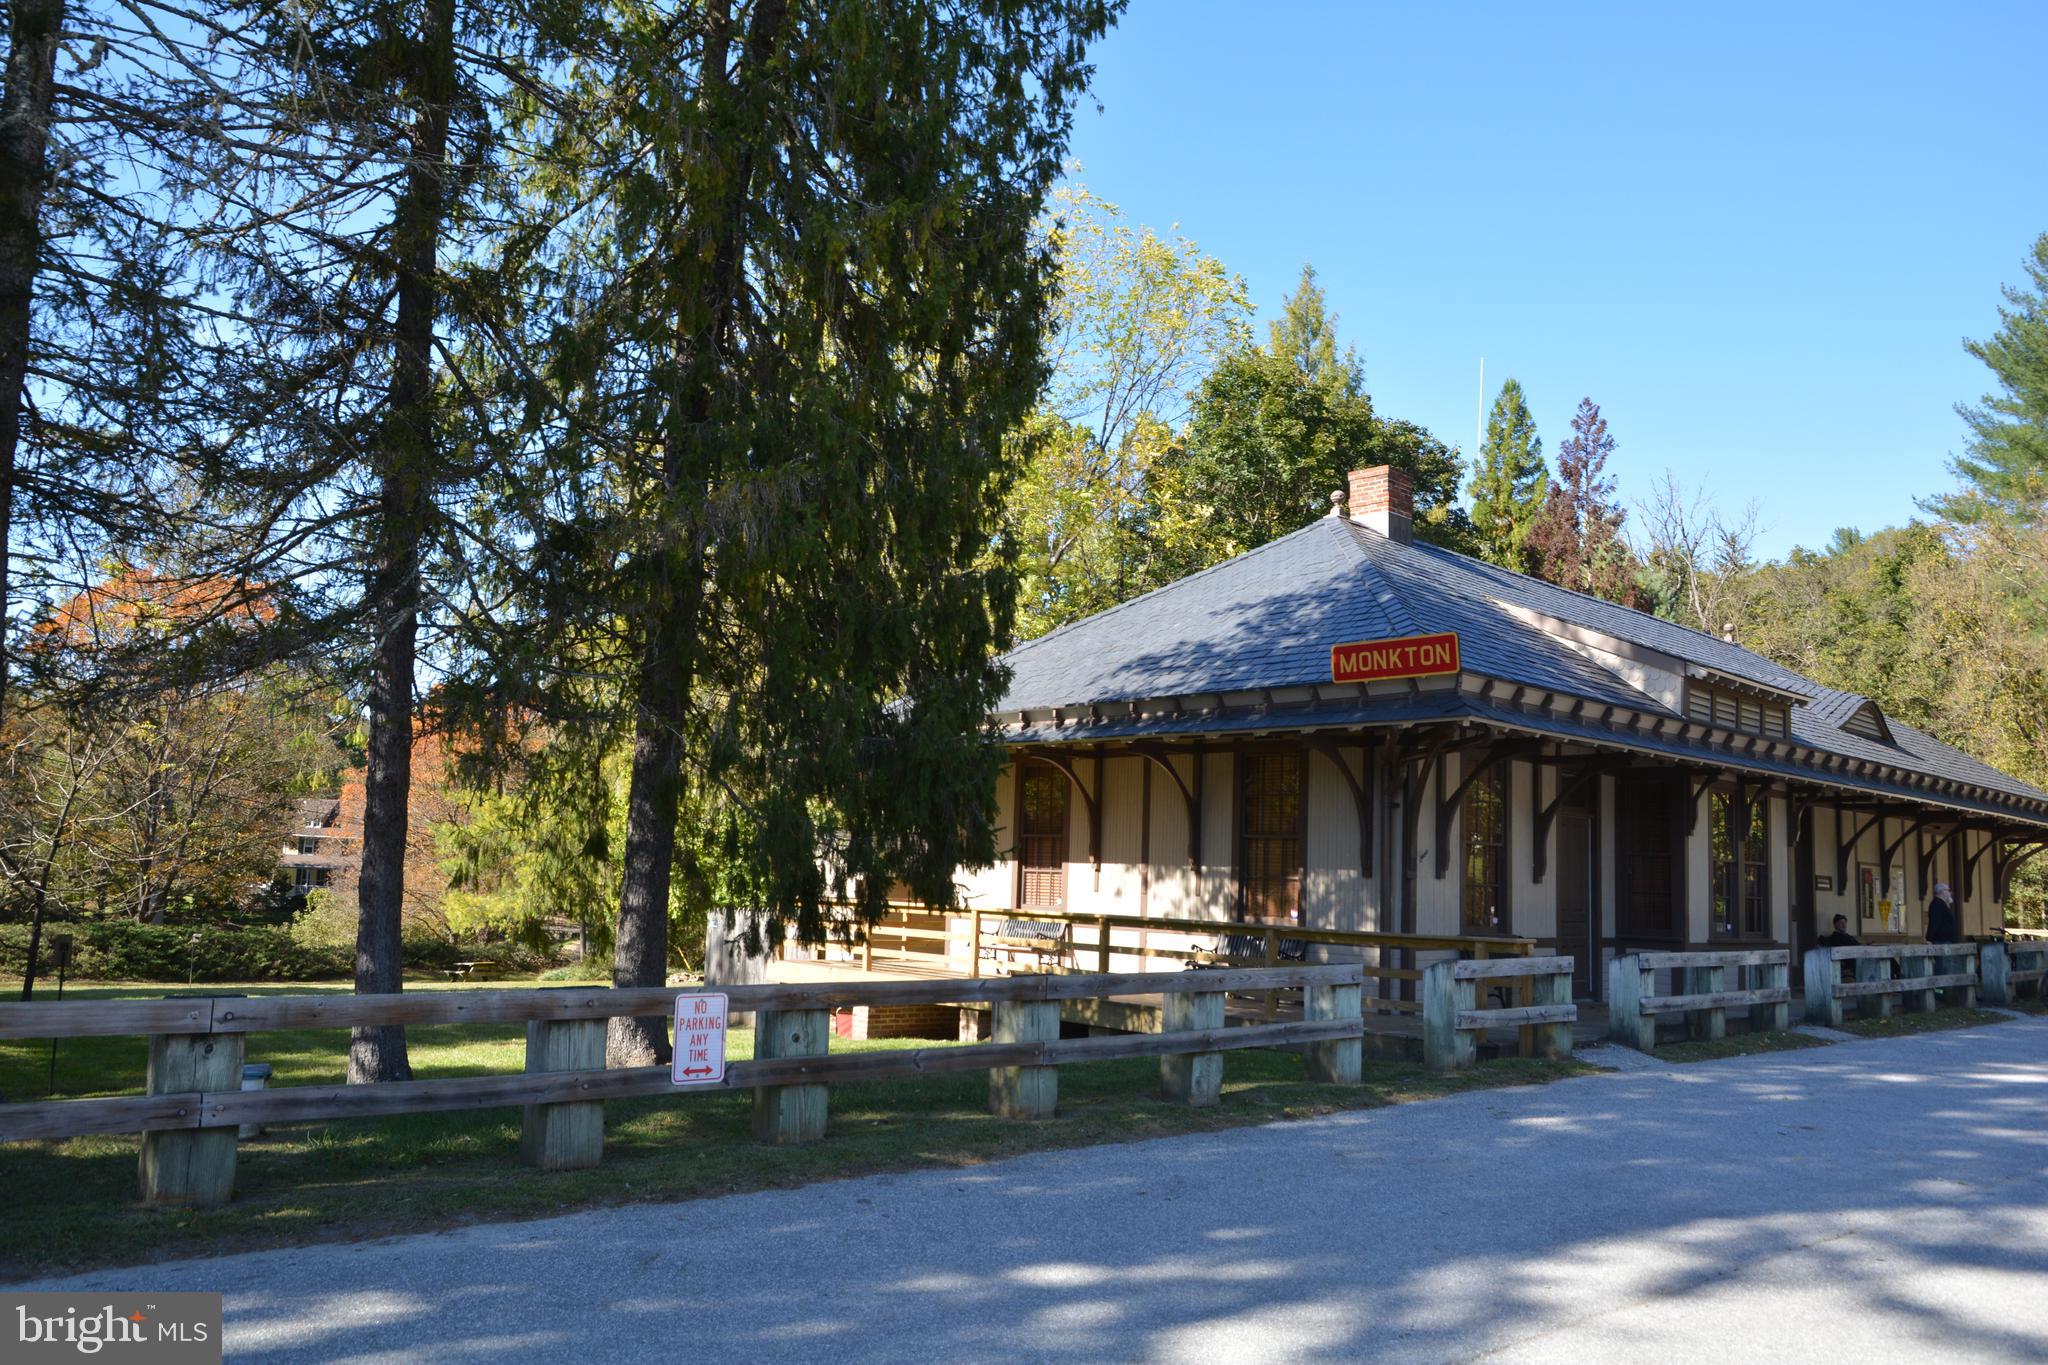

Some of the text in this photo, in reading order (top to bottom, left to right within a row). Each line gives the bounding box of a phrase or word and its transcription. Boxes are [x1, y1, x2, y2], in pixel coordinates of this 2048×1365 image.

[1339, 642, 1451, 674] MONKTON
[694, 1000, 708, 1015] NO
[679, 1016, 721, 1031] PARKING
[689, 1033, 709, 1047] ANY
[689, 1048, 708, 1063] TIME
